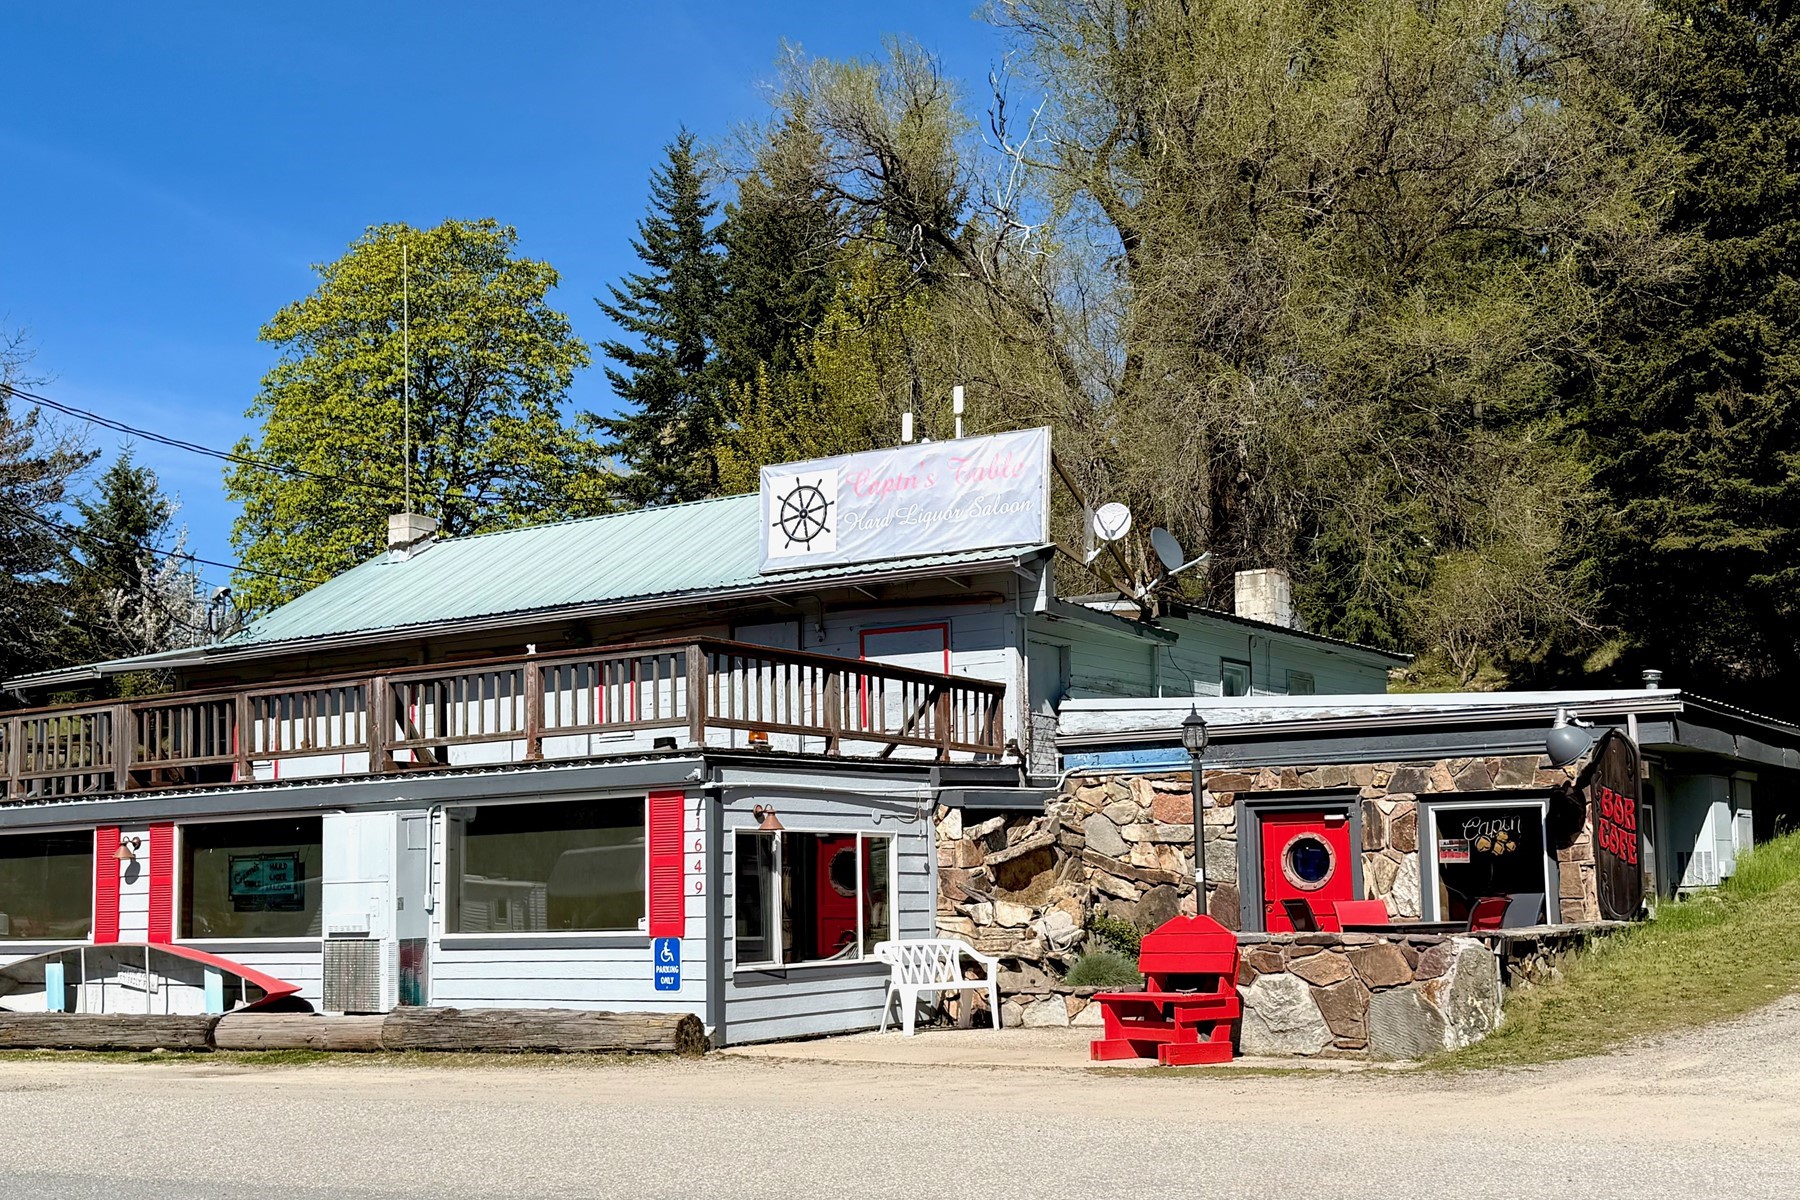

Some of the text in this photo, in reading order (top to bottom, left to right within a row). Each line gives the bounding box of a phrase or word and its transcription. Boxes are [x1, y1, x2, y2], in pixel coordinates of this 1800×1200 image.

[949, 451, 1024, 485] Table
[845, 494, 1034, 531] Hard Liquor Saloon
[1600, 786, 1636, 831] BAR
[1598, 817, 1637, 865] CAFE
[655, 965, 680, 974] PARKING
[660, 977, 675, 985] ONLY
